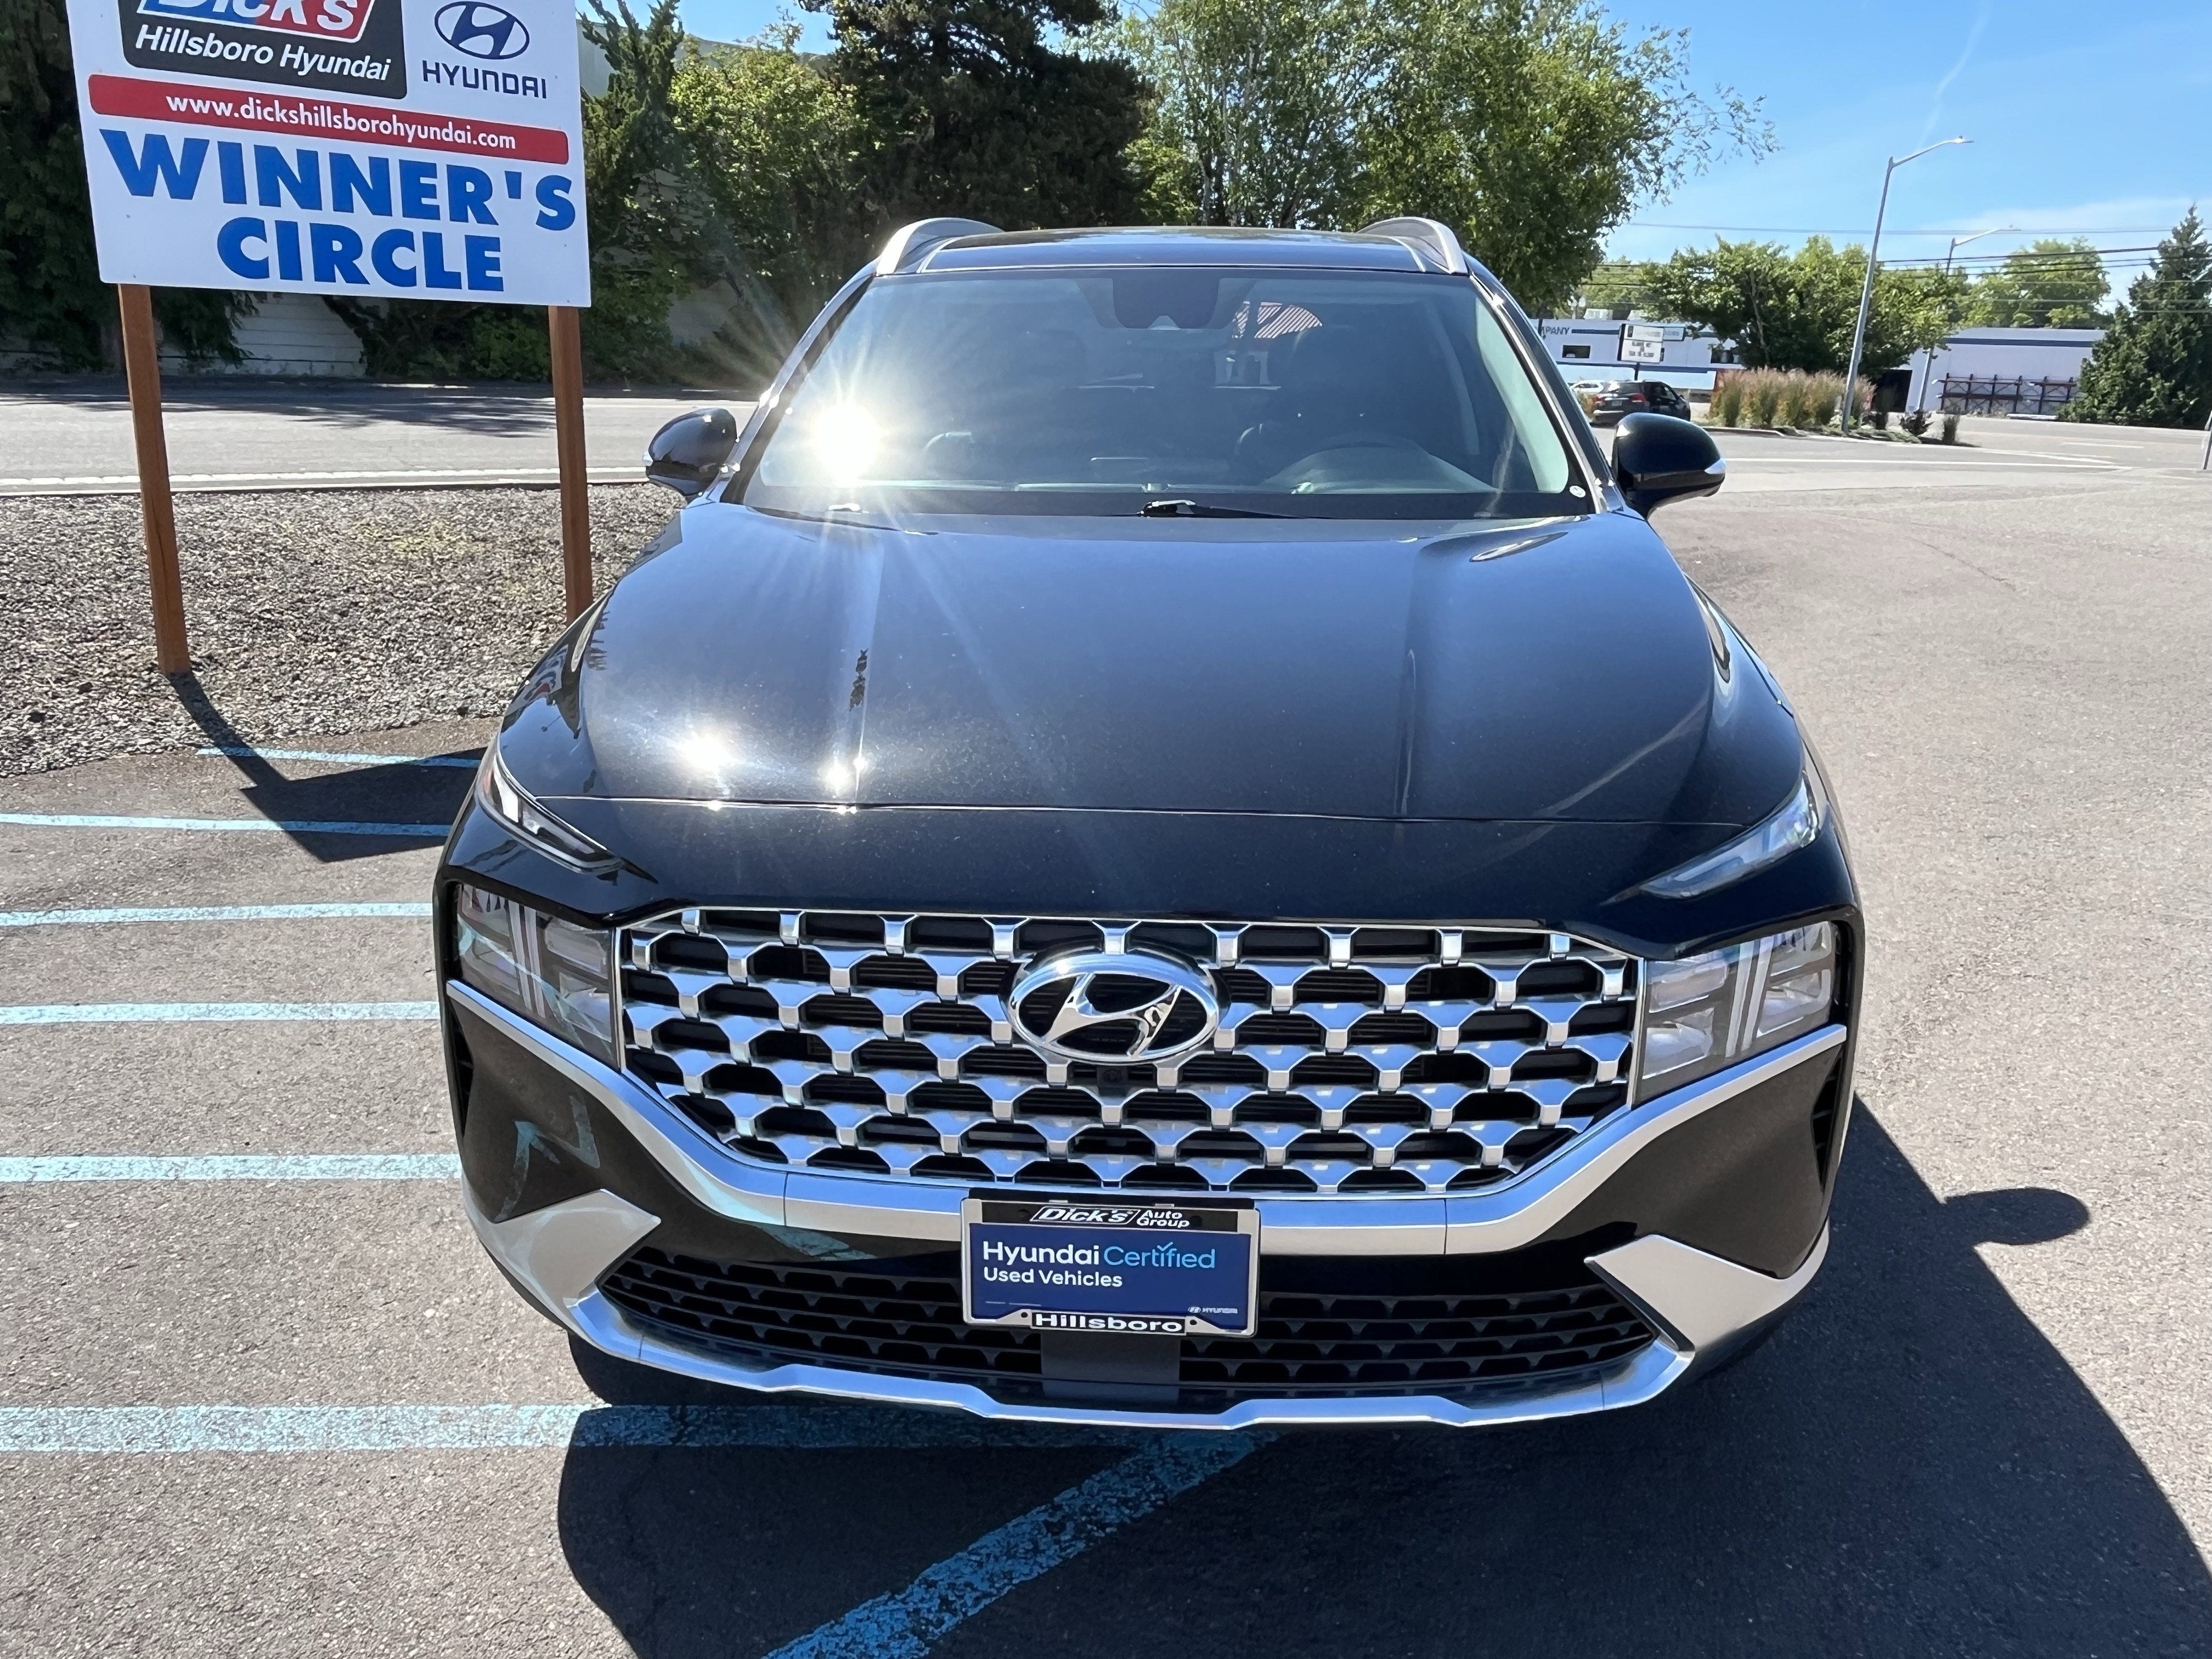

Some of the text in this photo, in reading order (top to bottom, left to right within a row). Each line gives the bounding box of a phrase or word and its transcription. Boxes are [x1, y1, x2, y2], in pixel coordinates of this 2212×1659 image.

[135, 24, 392, 81] Hillsboro Hyundai
[422, 60, 547, 99] HYUNDAI
[166, 95, 516, 150] www.dickshillsborohyundai.com
[99, 129, 576, 231] WINNER'S
[217, 217, 504, 292] CIRCLE
[1541, 326, 1570, 335] PANY
[1136, 1216, 1190, 1228] Group
[1141, 1210, 1183, 1220] Auto
[983, 1241, 1216, 1268] Hyundai Certified
[984, 1267, 1123, 1288] Used Vehicles
[1035, 1313, 1183, 1332] Hillsboro
